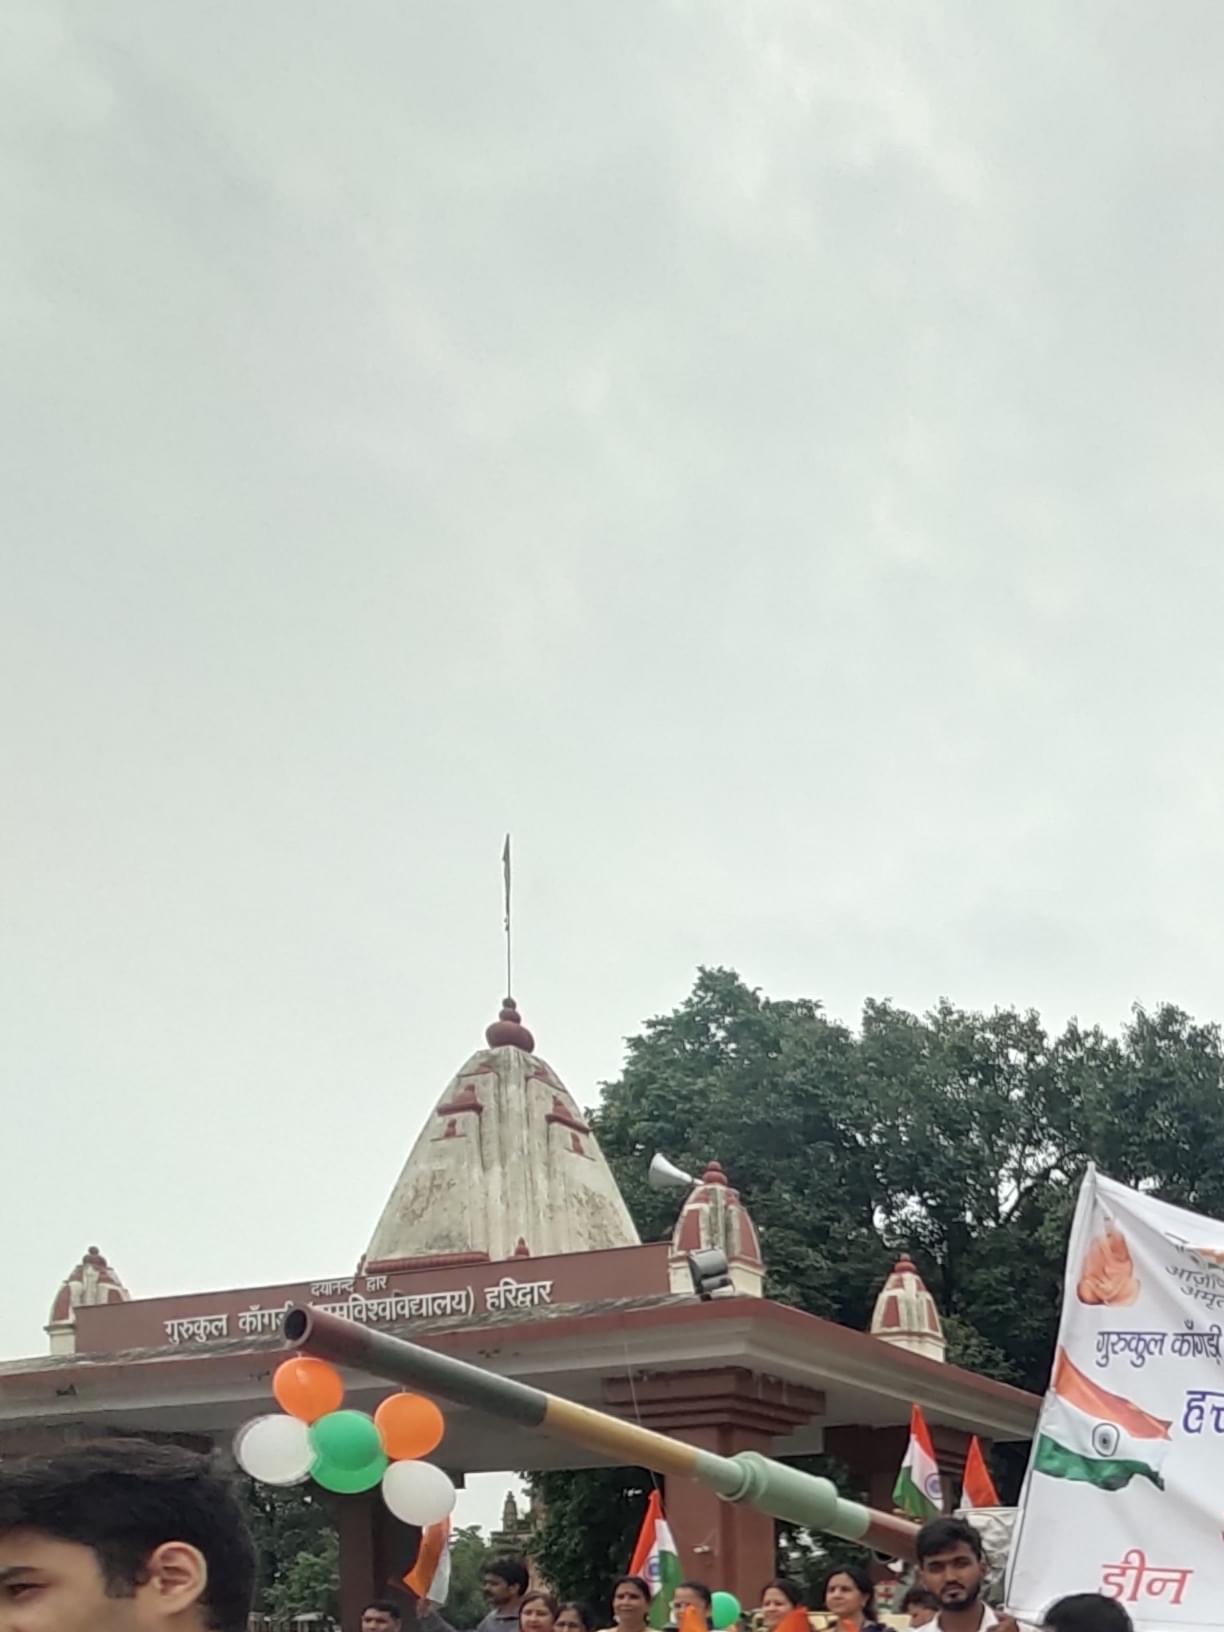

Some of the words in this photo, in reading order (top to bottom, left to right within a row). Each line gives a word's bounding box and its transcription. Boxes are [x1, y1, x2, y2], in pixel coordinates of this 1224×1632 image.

[311, 1278, 355, 1297] दयानन्द
[366, 1275, 388, 1290] द्वार
[164, 1314, 229, 1344] गुरुकुल
[484, 1277, 553, 1311] हरिद्वार
[1096, 1331, 1168, 1368] गुरुकुल
[1099, 1548, 1194, 1605] डीन
